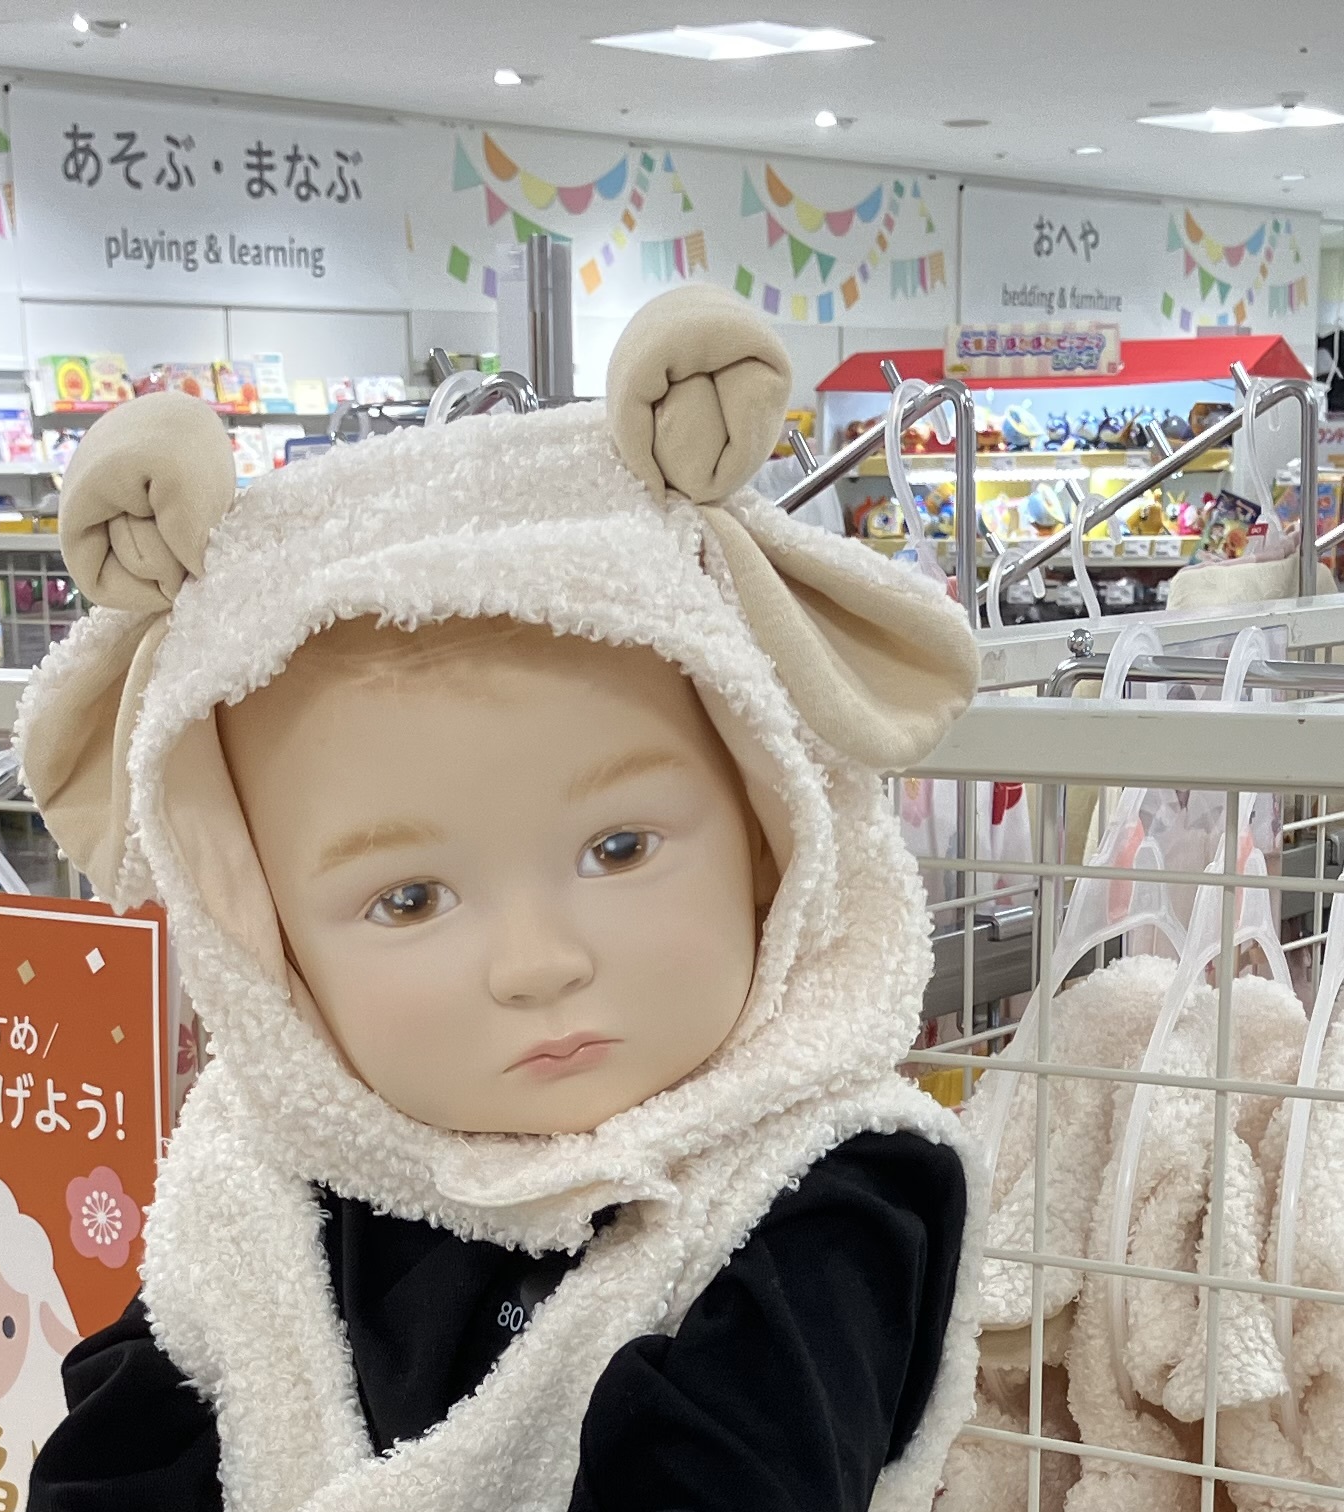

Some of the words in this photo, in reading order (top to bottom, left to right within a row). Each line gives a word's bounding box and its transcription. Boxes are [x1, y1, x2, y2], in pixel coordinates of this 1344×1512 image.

[61, 122, 364, 203] あそぶ・まなぶ
[105, 228, 199, 272] playing
[205, 234, 222, 264] &
[228, 233, 326, 277] learning
[1033, 214, 1100, 262] おへや
[1001, 282, 1055, 315] bedding
[1069, 285, 1123, 312] furniture
